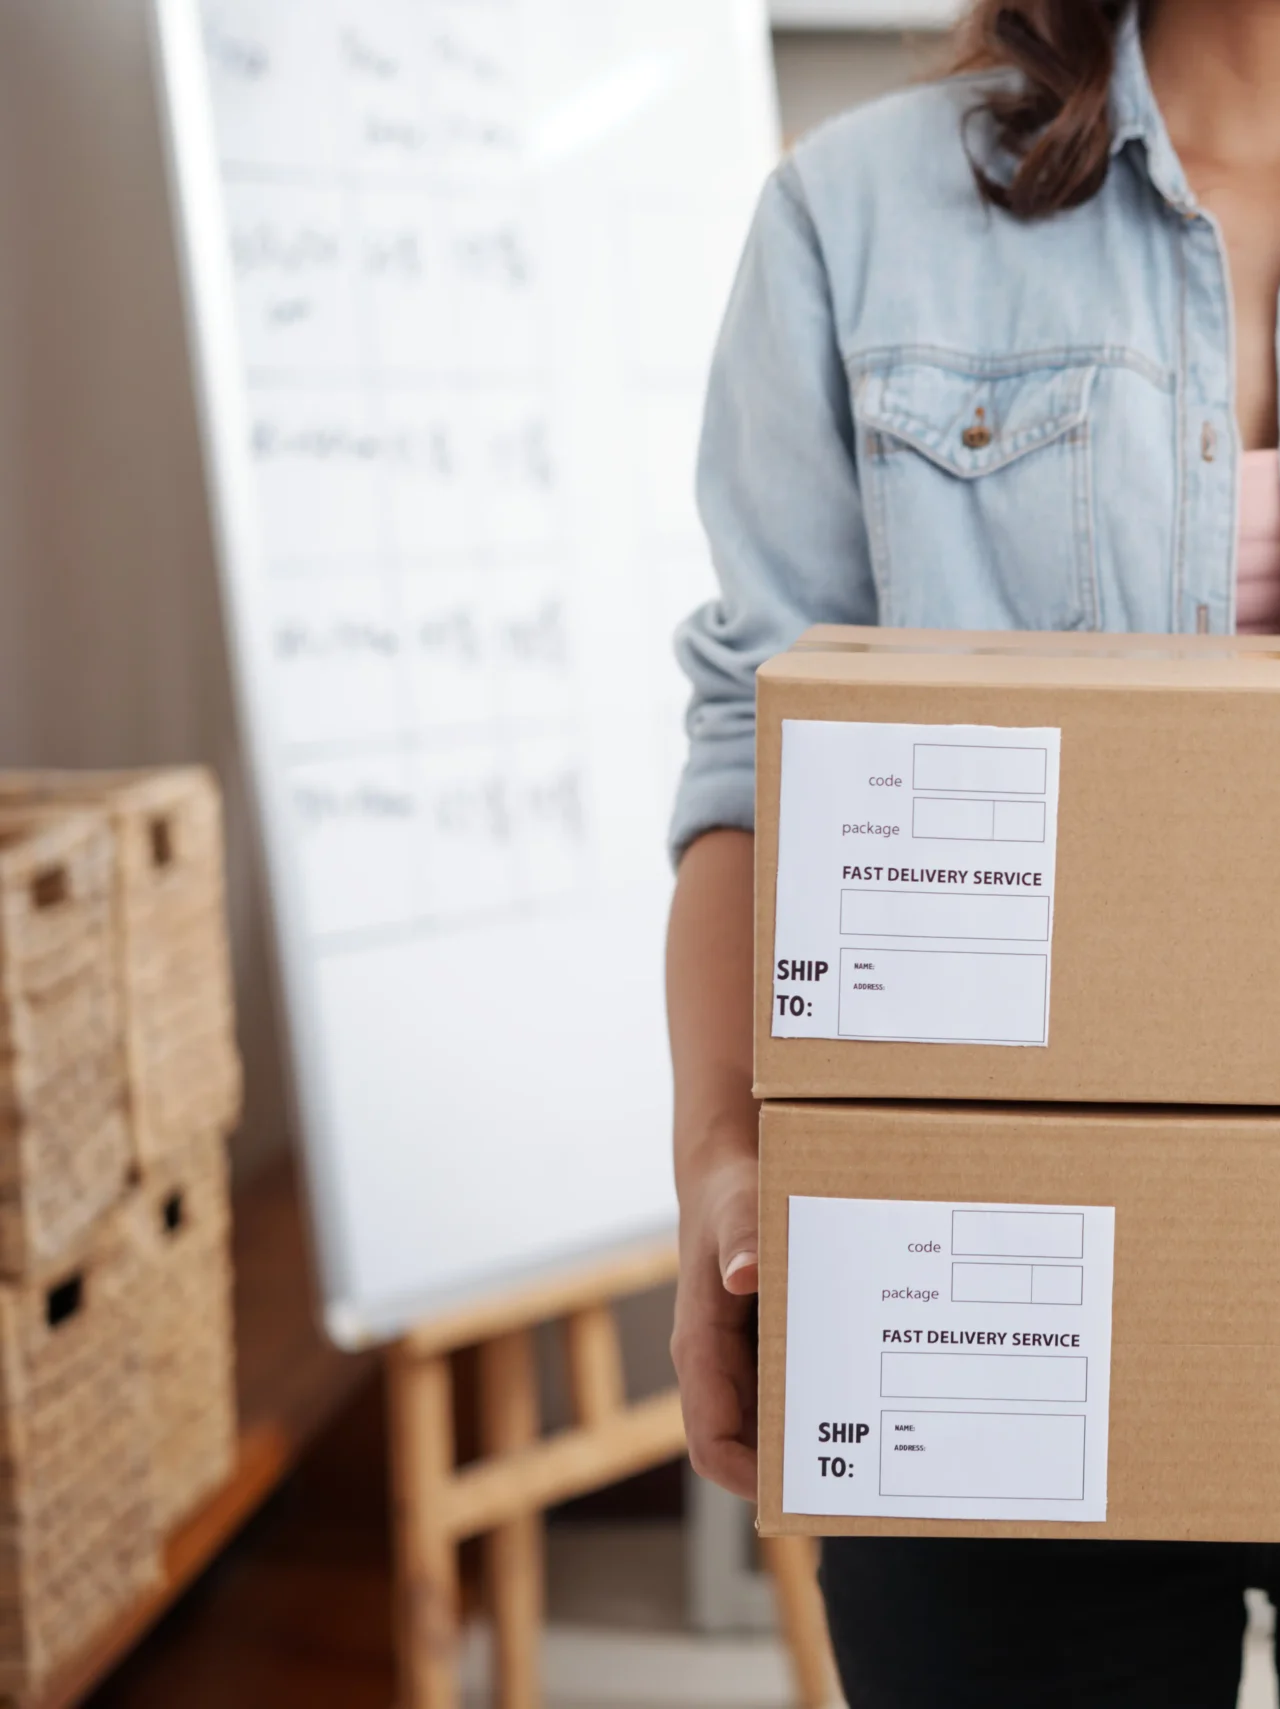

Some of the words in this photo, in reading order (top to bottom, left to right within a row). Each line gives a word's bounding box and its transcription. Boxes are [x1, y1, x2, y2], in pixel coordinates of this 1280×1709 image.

[868, 774, 903, 788] code
[842, 821, 900, 839] package
[842, 865, 884, 881] FAST
[887, 867, 969, 884] DELIVERY
[973, 870, 1042, 887] SERVICE
[776, 958, 829, 982] SHIP
[853, 962, 875, 970] NAME:
[852, 982, 885, 991] ADDRESS:
[776, 994, 813, 1017] TO:
[907, 1240, 942, 1253] code
[881, 1286, 940, 1303] package
[882, 1329, 924, 1344] FAST
[927, 1330, 1008, 1346] DELIVERY
[1012, 1332, 1080, 1348] SERVICE
[818, 1421, 870, 1444] SHIP
[894, 1424, 915, 1432] NAME:
[893, 1444, 926, 1452] ADDRESS:
[817, 1456, 854, 1479] TO:
